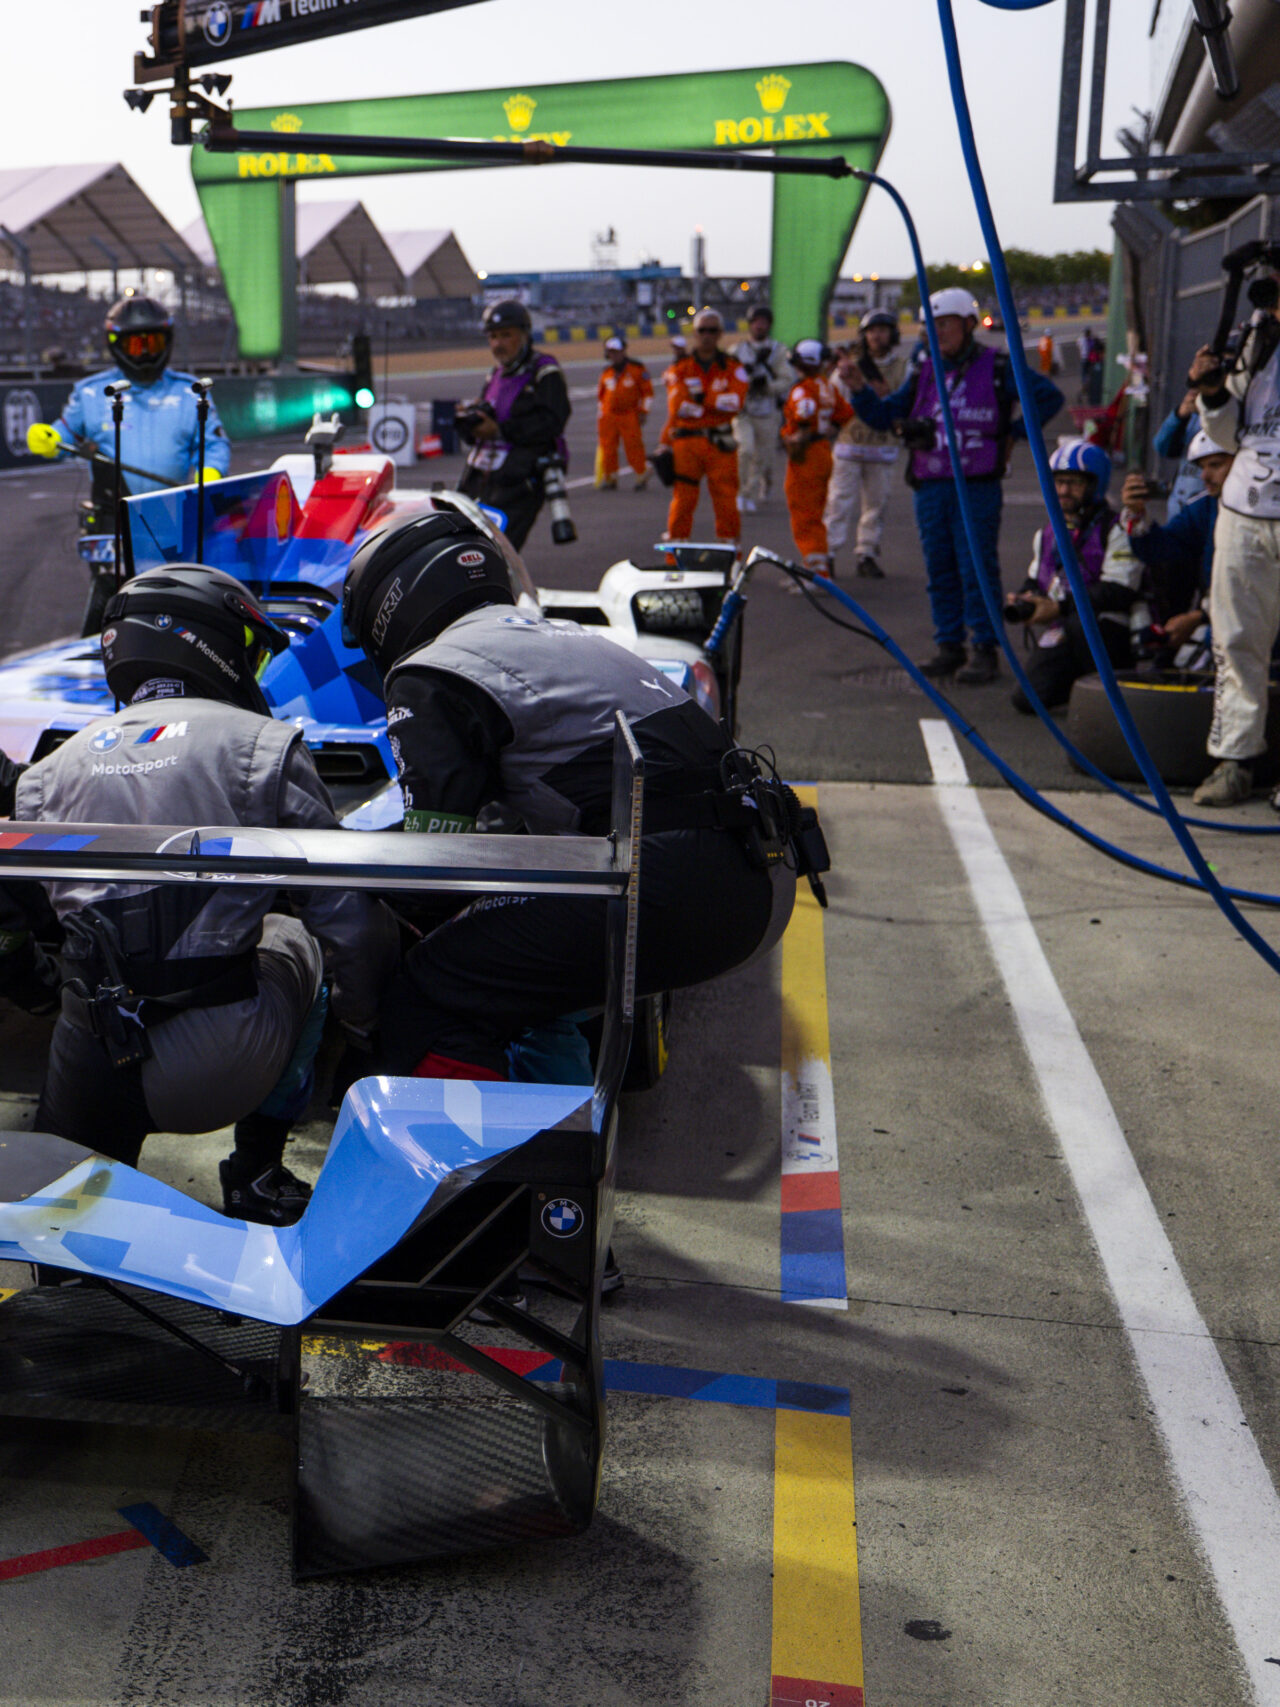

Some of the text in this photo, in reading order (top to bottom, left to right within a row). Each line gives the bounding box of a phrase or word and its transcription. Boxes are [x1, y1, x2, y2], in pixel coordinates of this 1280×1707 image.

[714, 112, 832, 145] ROLEX
[196, 640, 241, 682] Motorsport
[91, 754, 179, 776] Motorsport
